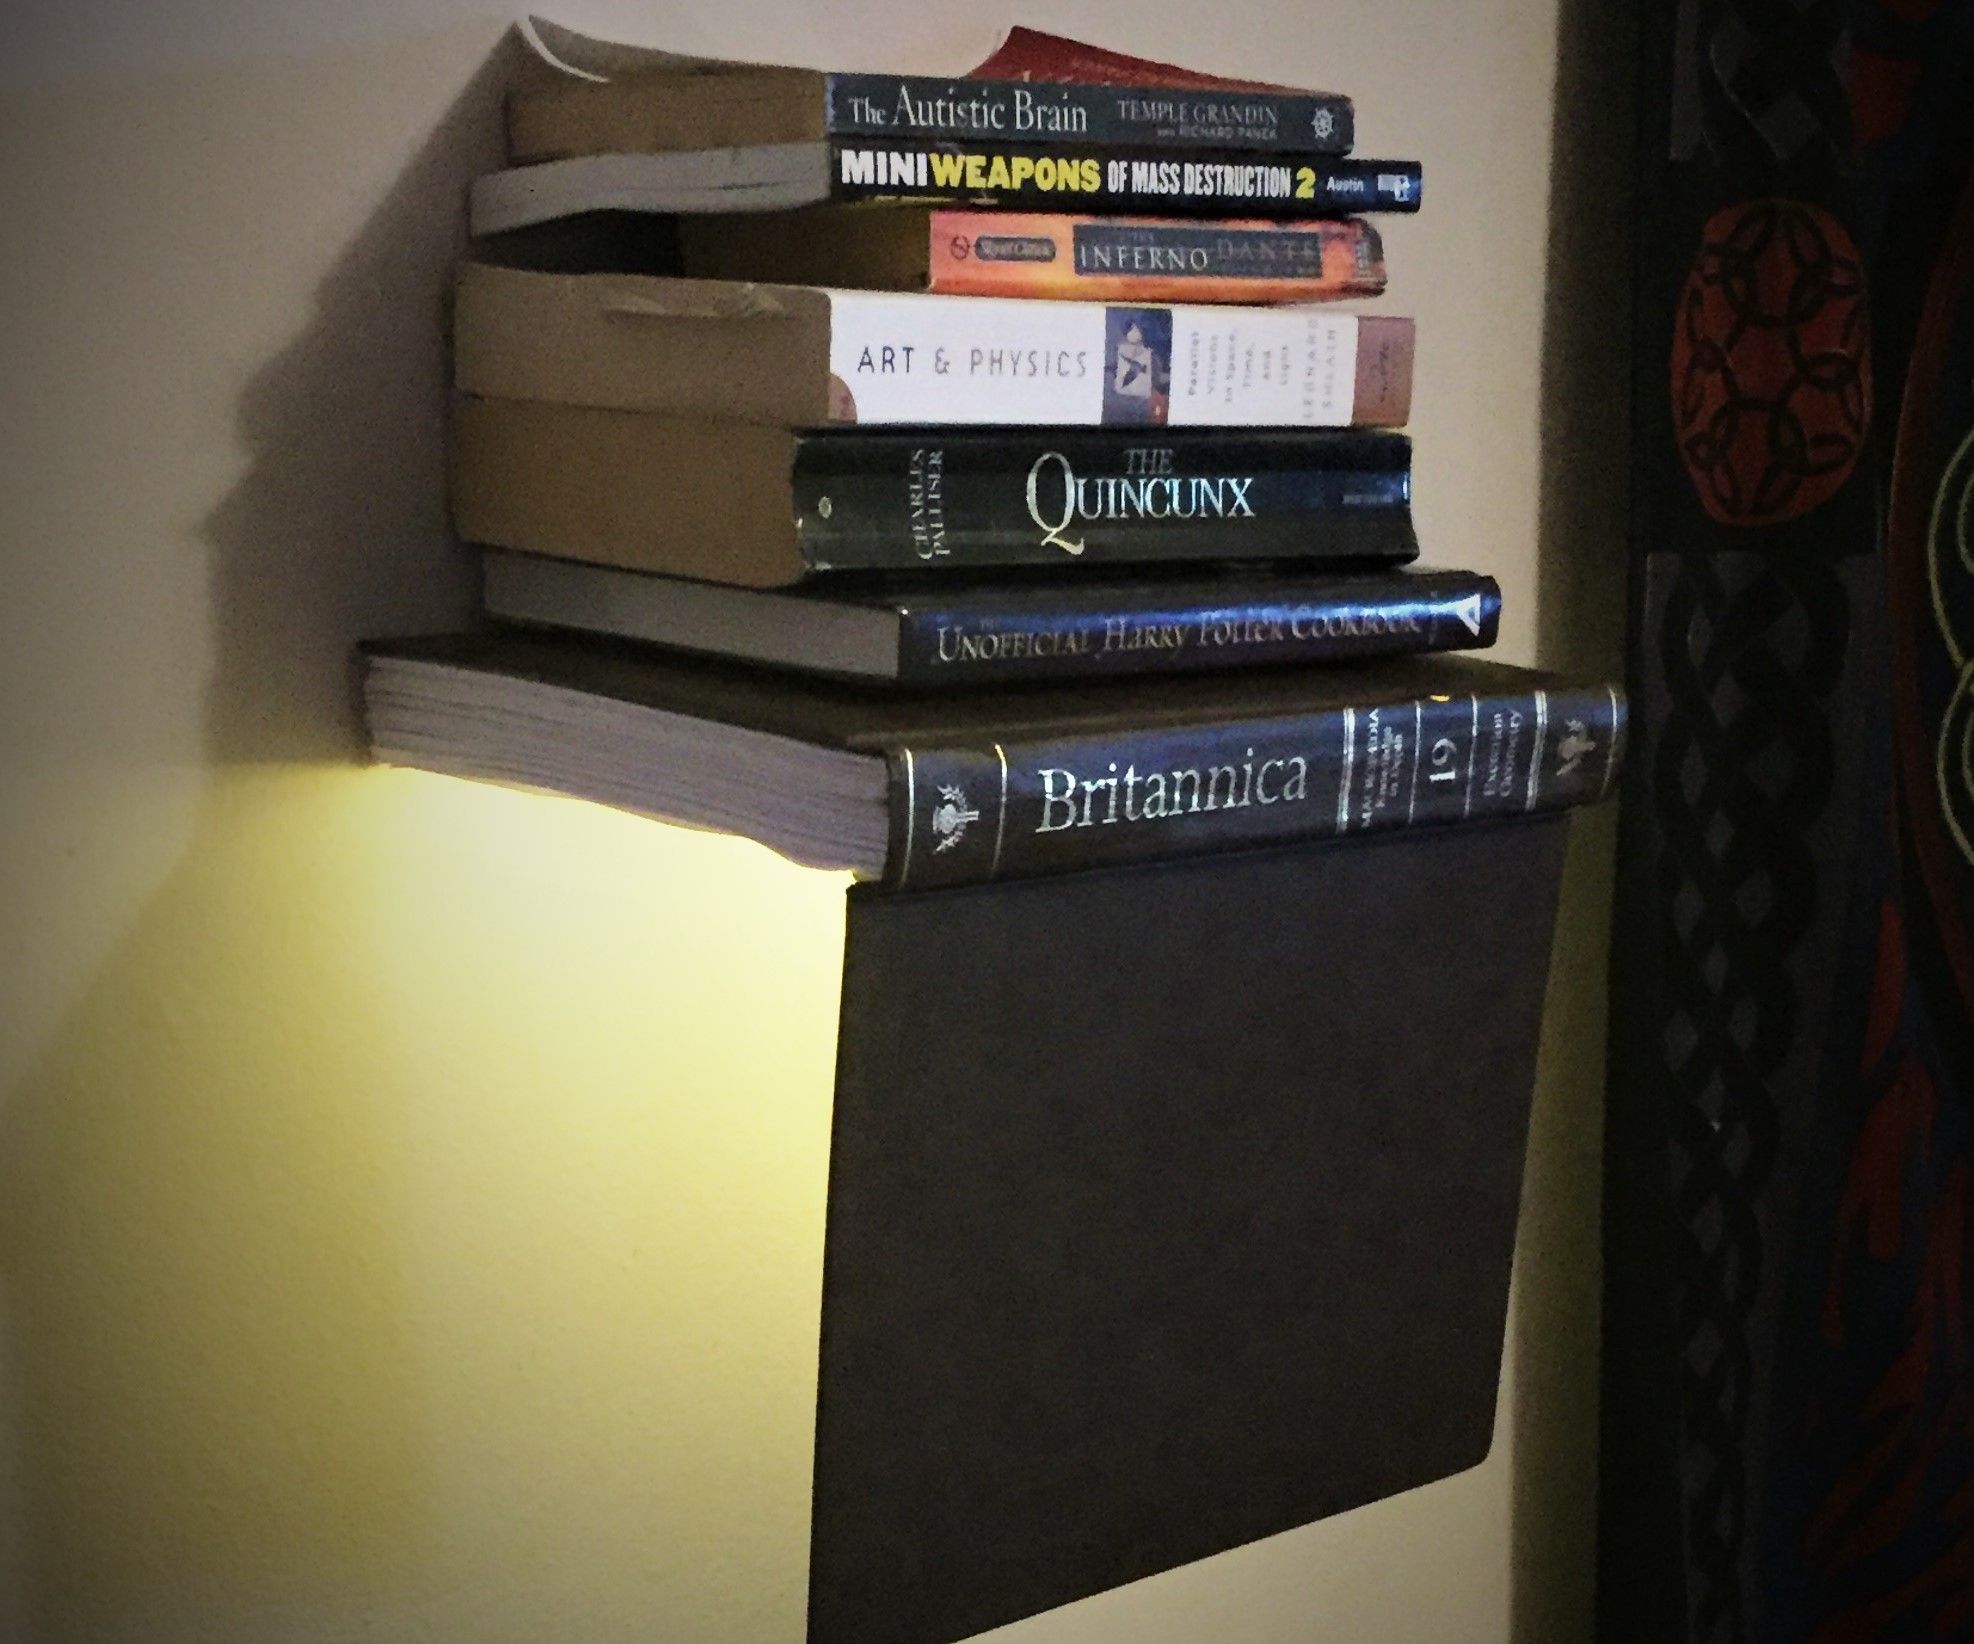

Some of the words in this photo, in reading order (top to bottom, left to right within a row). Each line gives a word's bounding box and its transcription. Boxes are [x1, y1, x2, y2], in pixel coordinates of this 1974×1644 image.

[849, 97, 887, 125] The
[892, 84, 1006, 130] Autistic
[1014, 89, 1088, 133] Brain
[1117, 99, 1188, 123] TEMPLE
[1192, 103, 1279, 125] GRANDIN
[1107, 159, 1129, 194] OF
[1131, 160, 1182, 196] MASS
[1183, 162, 1292, 198] DESTRUCTION
[1295, 166, 1317, 200] 2
[1080, 245, 1209, 272] INFERNO
[857, 345, 915, 374] ART
[934, 345, 951, 375] &
[969, 347, 1088, 377] PHYSICS
[1125, 448, 1175, 475] THE
[909, 448, 933, 560] CHARLES
[1025, 451, 1257, 556] QUINCUNX
[936, 624, 1089, 663] UNOFFICIAL
[1104, 614, 1190, 650] HARRY
[1428, 737, 1458, 784] 19
[1034, 746, 1309, 835] Britannica
